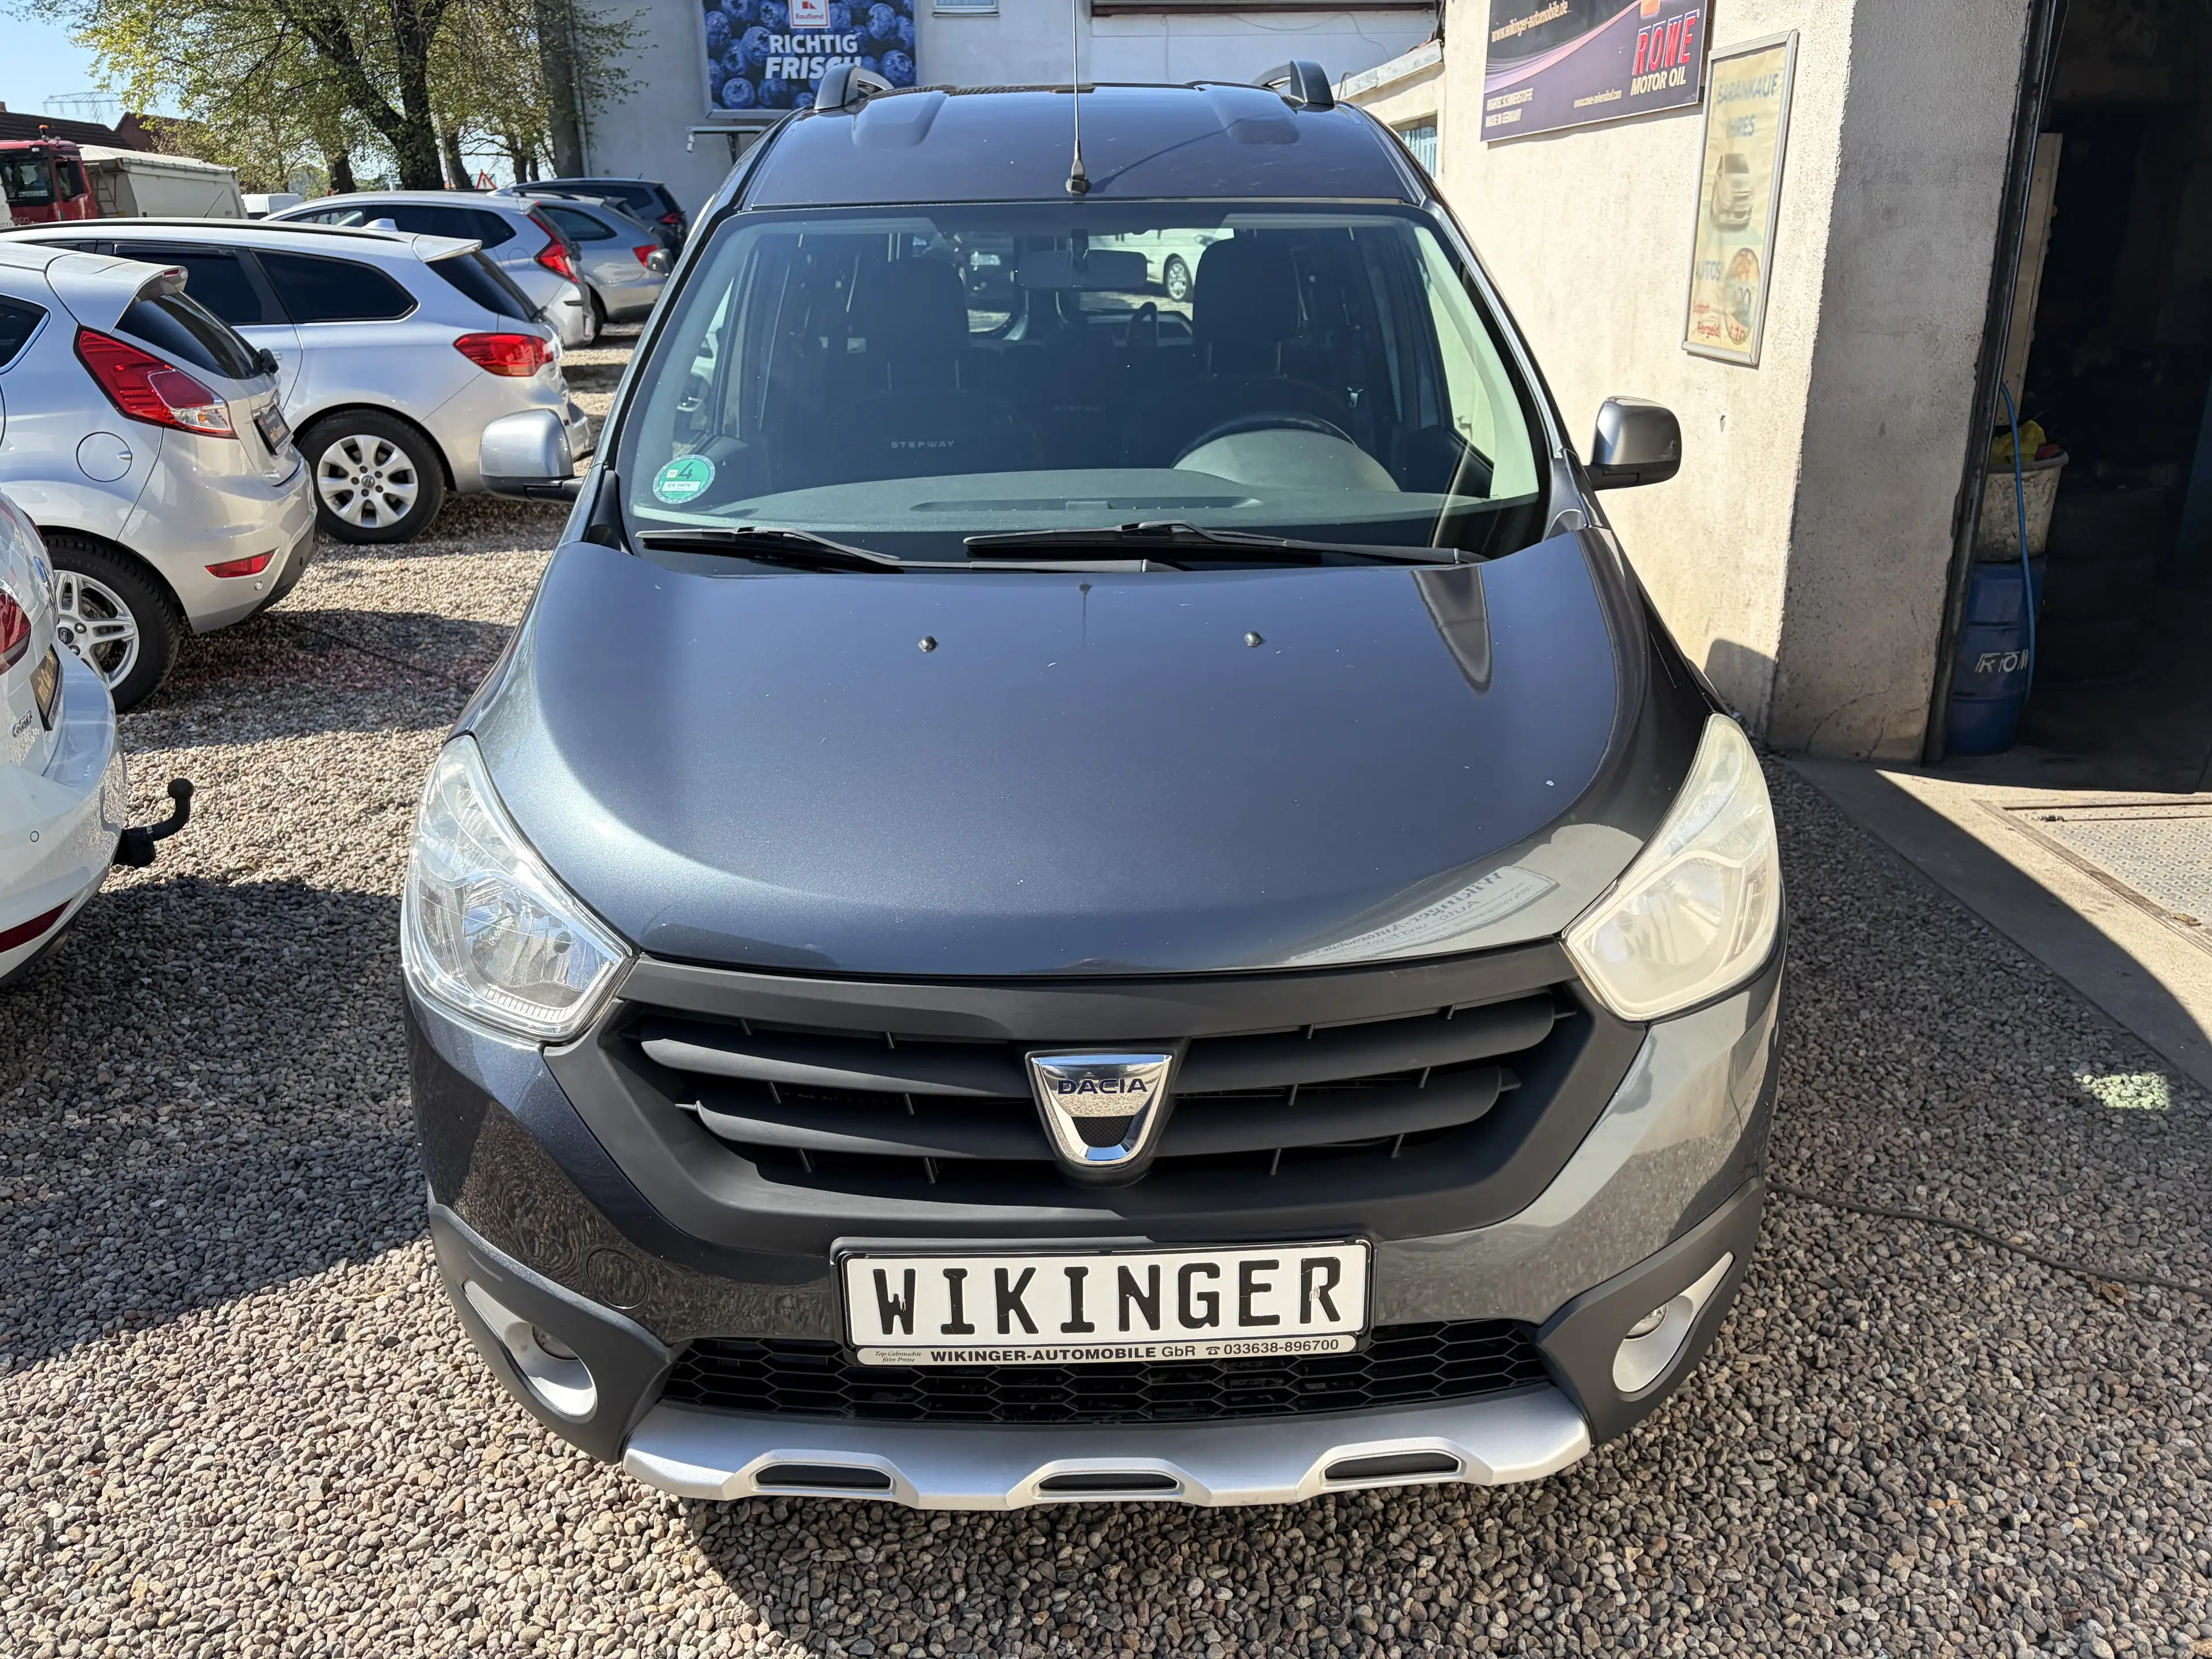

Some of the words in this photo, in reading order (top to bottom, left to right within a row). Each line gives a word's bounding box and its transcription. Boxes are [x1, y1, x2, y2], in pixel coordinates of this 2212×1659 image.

[768, 35, 858, 54] RICHTIG
[1632, 9, 1699, 75] ROWE
[764, 56, 862, 79] FRIS
[1630, 70, 1668, 96] MOTOR
[1668, 66, 1687, 88] OIL
[891, 440, 955, 449] STEPWAY
[679, 461, 693, 479] 4
[1058, 1078, 1148, 1094] DACIA
[873, 1256, 1342, 1335] WIKINGER
[930, 1347, 1157, 1362] WIKINGER-AUTOMOBILE
[1161, 1345, 1196, 1358] GbR
[1224, 1339, 1339, 1355] 033638-896700
